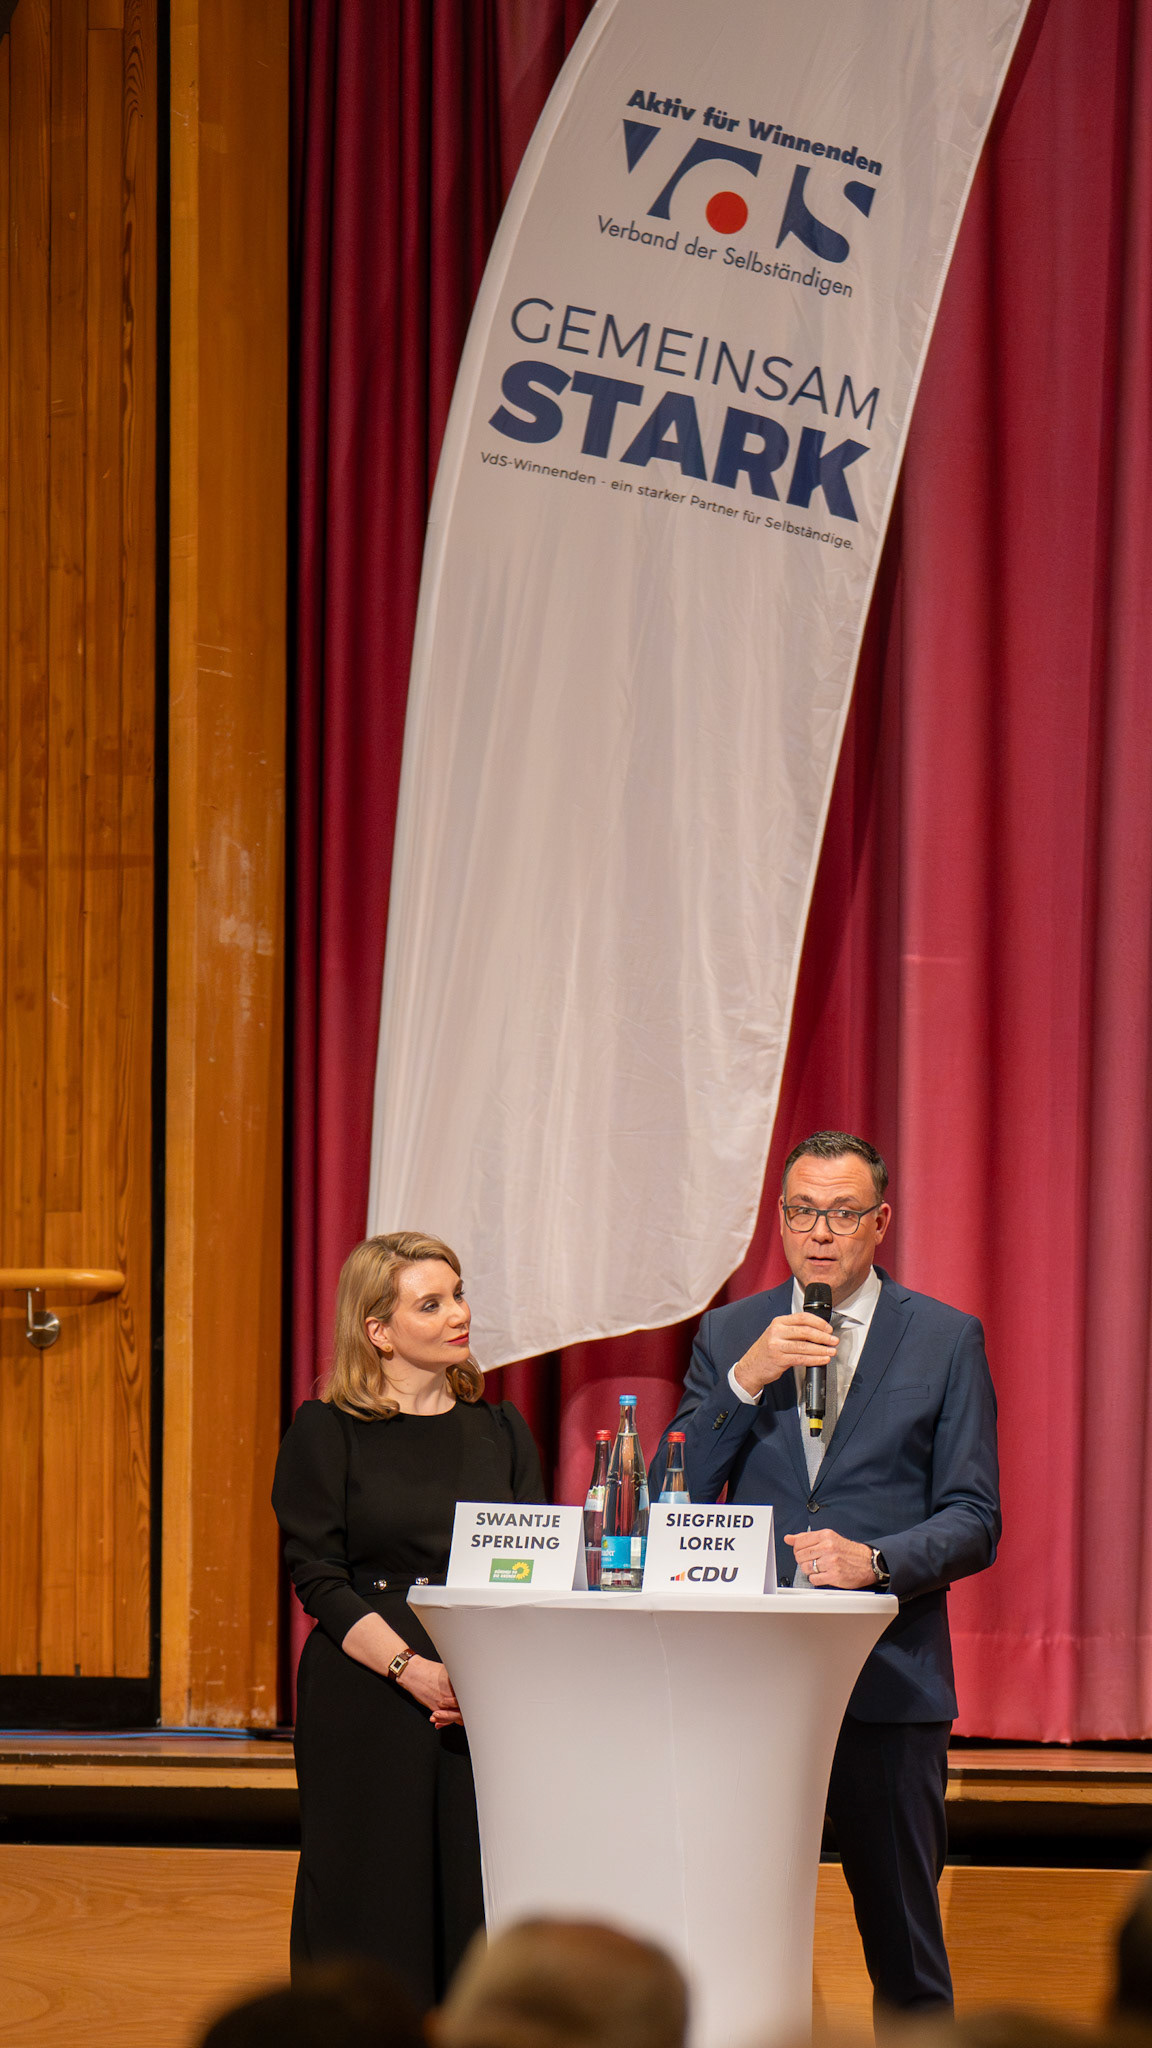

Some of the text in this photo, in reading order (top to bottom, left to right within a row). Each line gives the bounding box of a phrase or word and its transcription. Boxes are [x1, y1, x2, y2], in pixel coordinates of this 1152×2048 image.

[626, 89, 883, 176] Aktiv für Winnenden
[598, 214, 854, 298] Verband der Selbständigen
[510, 297, 881, 431] GEMEINSAM
[488, 360, 871, 523] STARK
[480, 451, 597, 486] VdS-Winnenden
[611, 479, 633, 494] ein
[637, 484, 687, 505] starker
[690, 495, 739, 518] Partner
[742, 508, 762, 525] für
[764, 516, 855, 551] Selbständige.
[471, 1534, 560, 1550] SPERLING
[476, 1512, 561, 1528] SWANTJE
[666, 1513, 754, 1529] SIEGFRIED
[679, 1536, 736, 1551] LOREK
[687, 1566, 739, 1582] CDU
